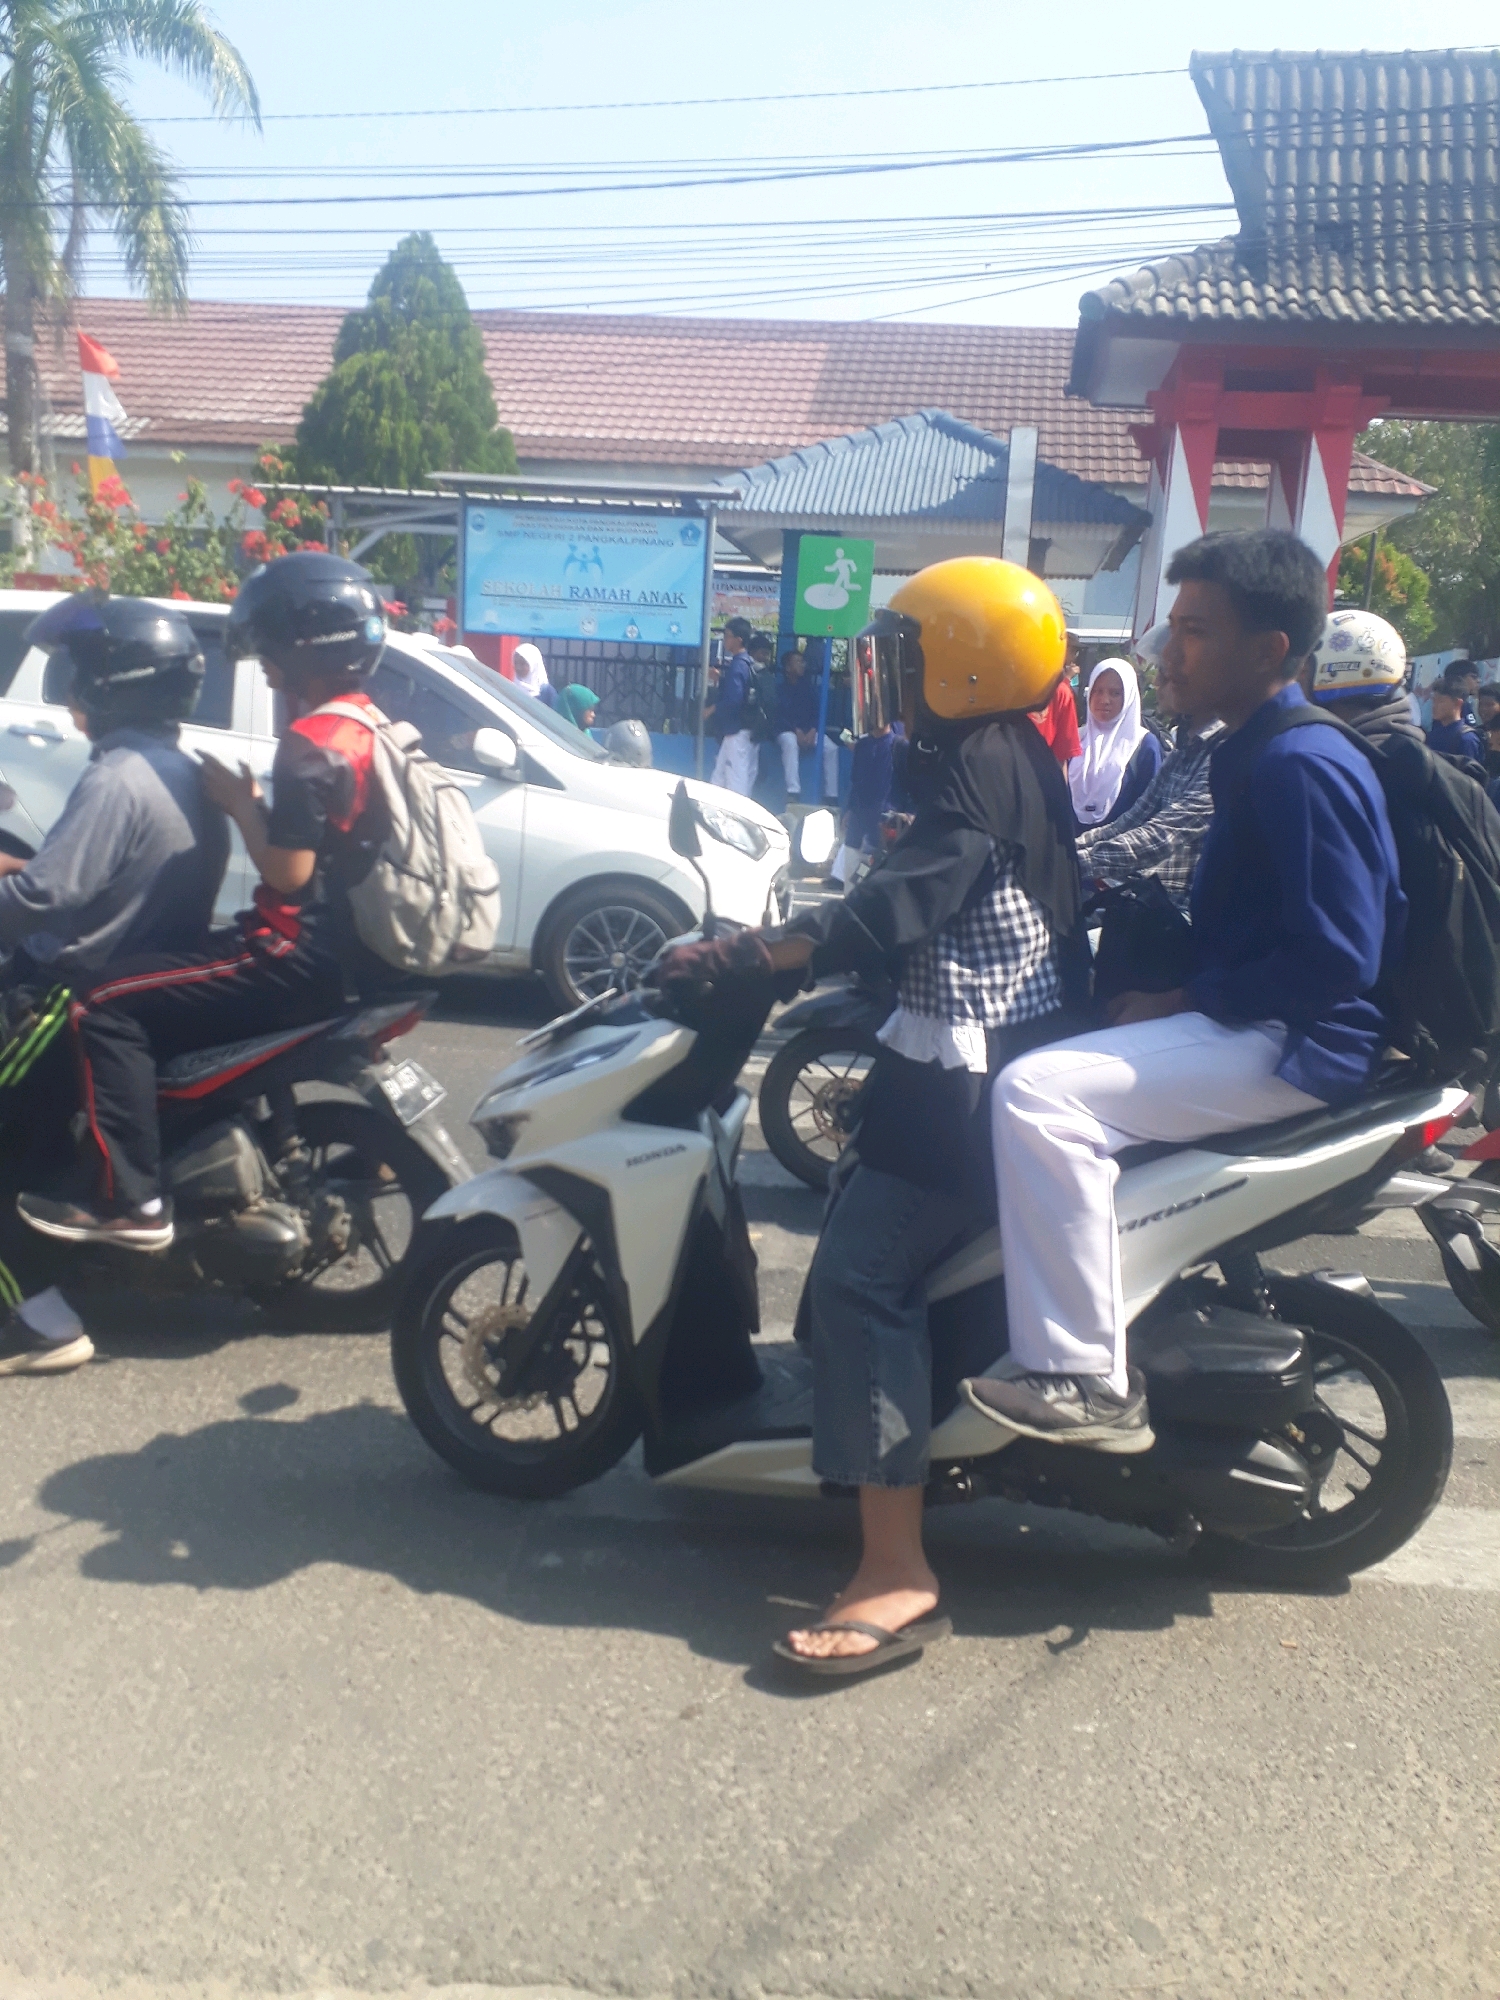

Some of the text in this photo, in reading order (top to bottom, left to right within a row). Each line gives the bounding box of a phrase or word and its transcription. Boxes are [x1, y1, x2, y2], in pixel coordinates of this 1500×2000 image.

[497, 529, 519, 538] SMP
[523, 530, 566, 541] NEGERI
[576, 534, 674, 548] PANGKALPINANG
[482, 579, 686, 605] SEKOLAH RAMAH ANAK
[626, 1144, 687, 1168] HONDA
